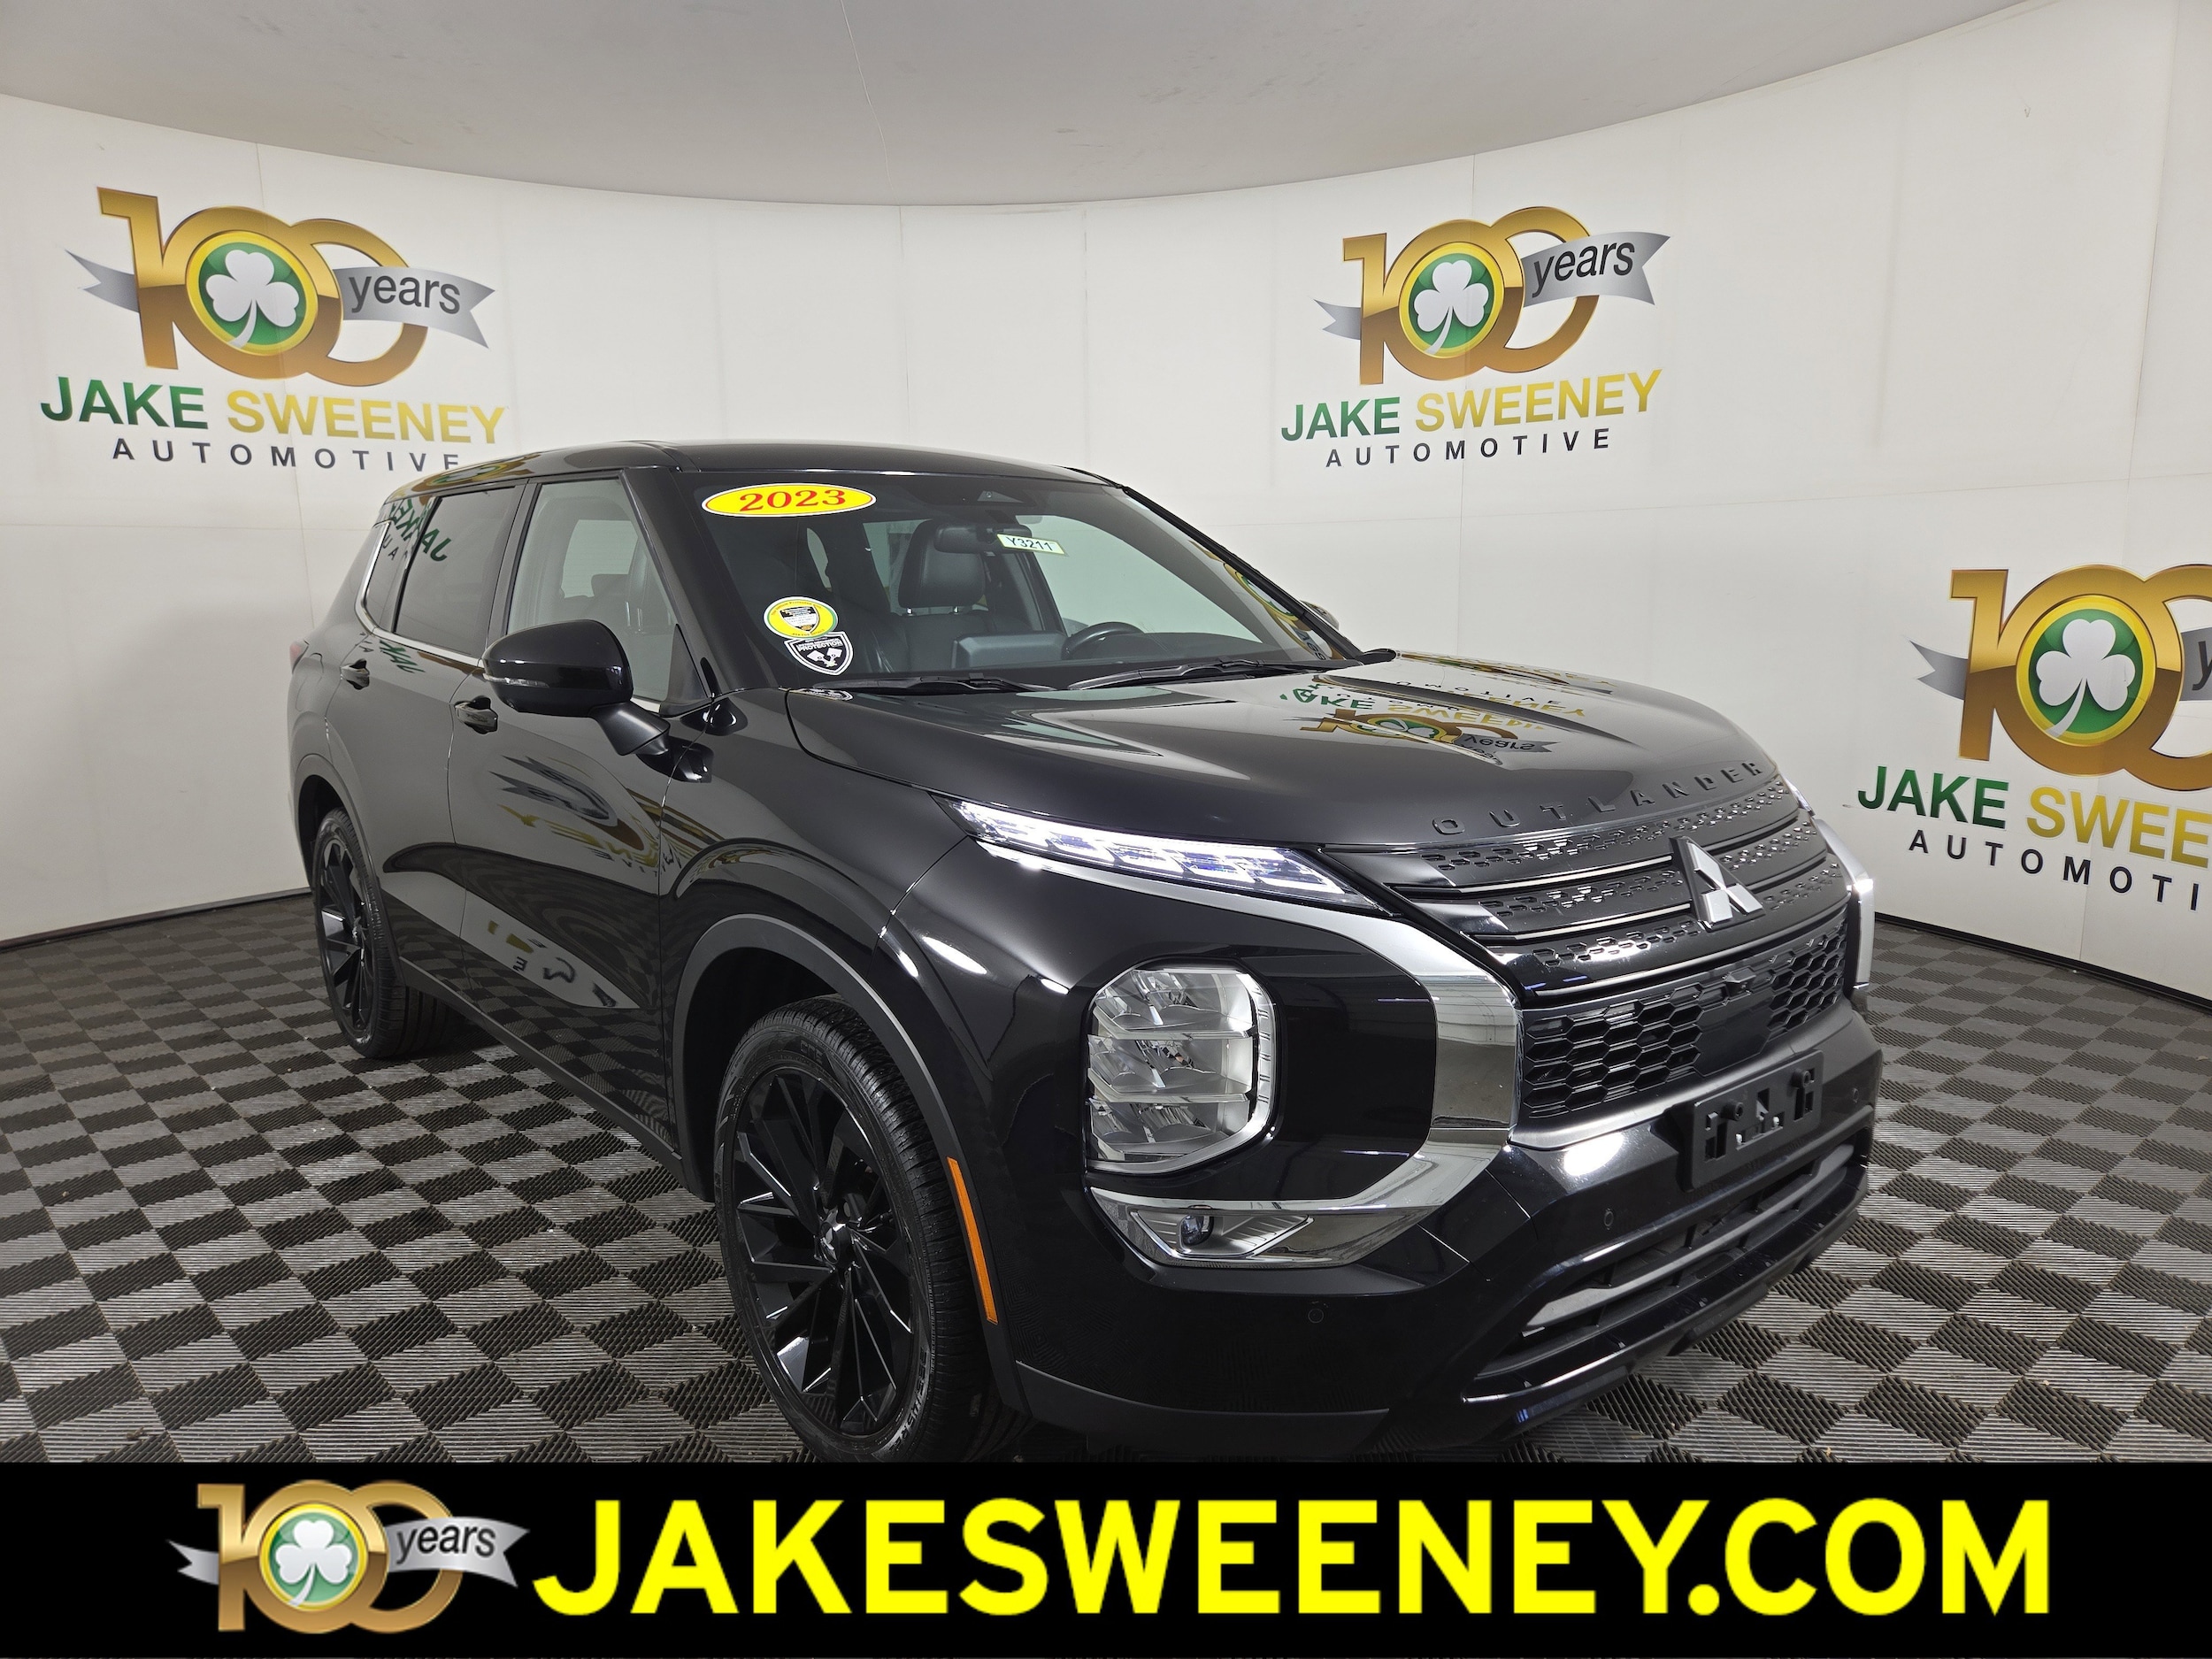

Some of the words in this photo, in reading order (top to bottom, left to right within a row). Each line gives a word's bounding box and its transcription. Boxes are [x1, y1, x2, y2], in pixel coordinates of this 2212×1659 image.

[96, 187, 428, 387] 100
[349, 273, 460, 314] years
[1342, 205, 1600, 385] 100
[1532, 242, 1634, 297] years
[41, 375, 208, 429] JAKE
[227, 390, 504, 443] SWEENEY
[1281, 396, 1400, 441] JAKE
[1416, 369, 1663, 432] SWEENEY
[112, 438, 458, 472] AUTOMOTIVE
[1325, 427, 1609, 467] AUTOMOTIVE
[740, 489, 846, 511] 2023
[1006, 536, 1053, 551] Y3211
[1432, 762, 1763, 835] OUTLANDER
[1858, 765, 2008, 829] JAKE
